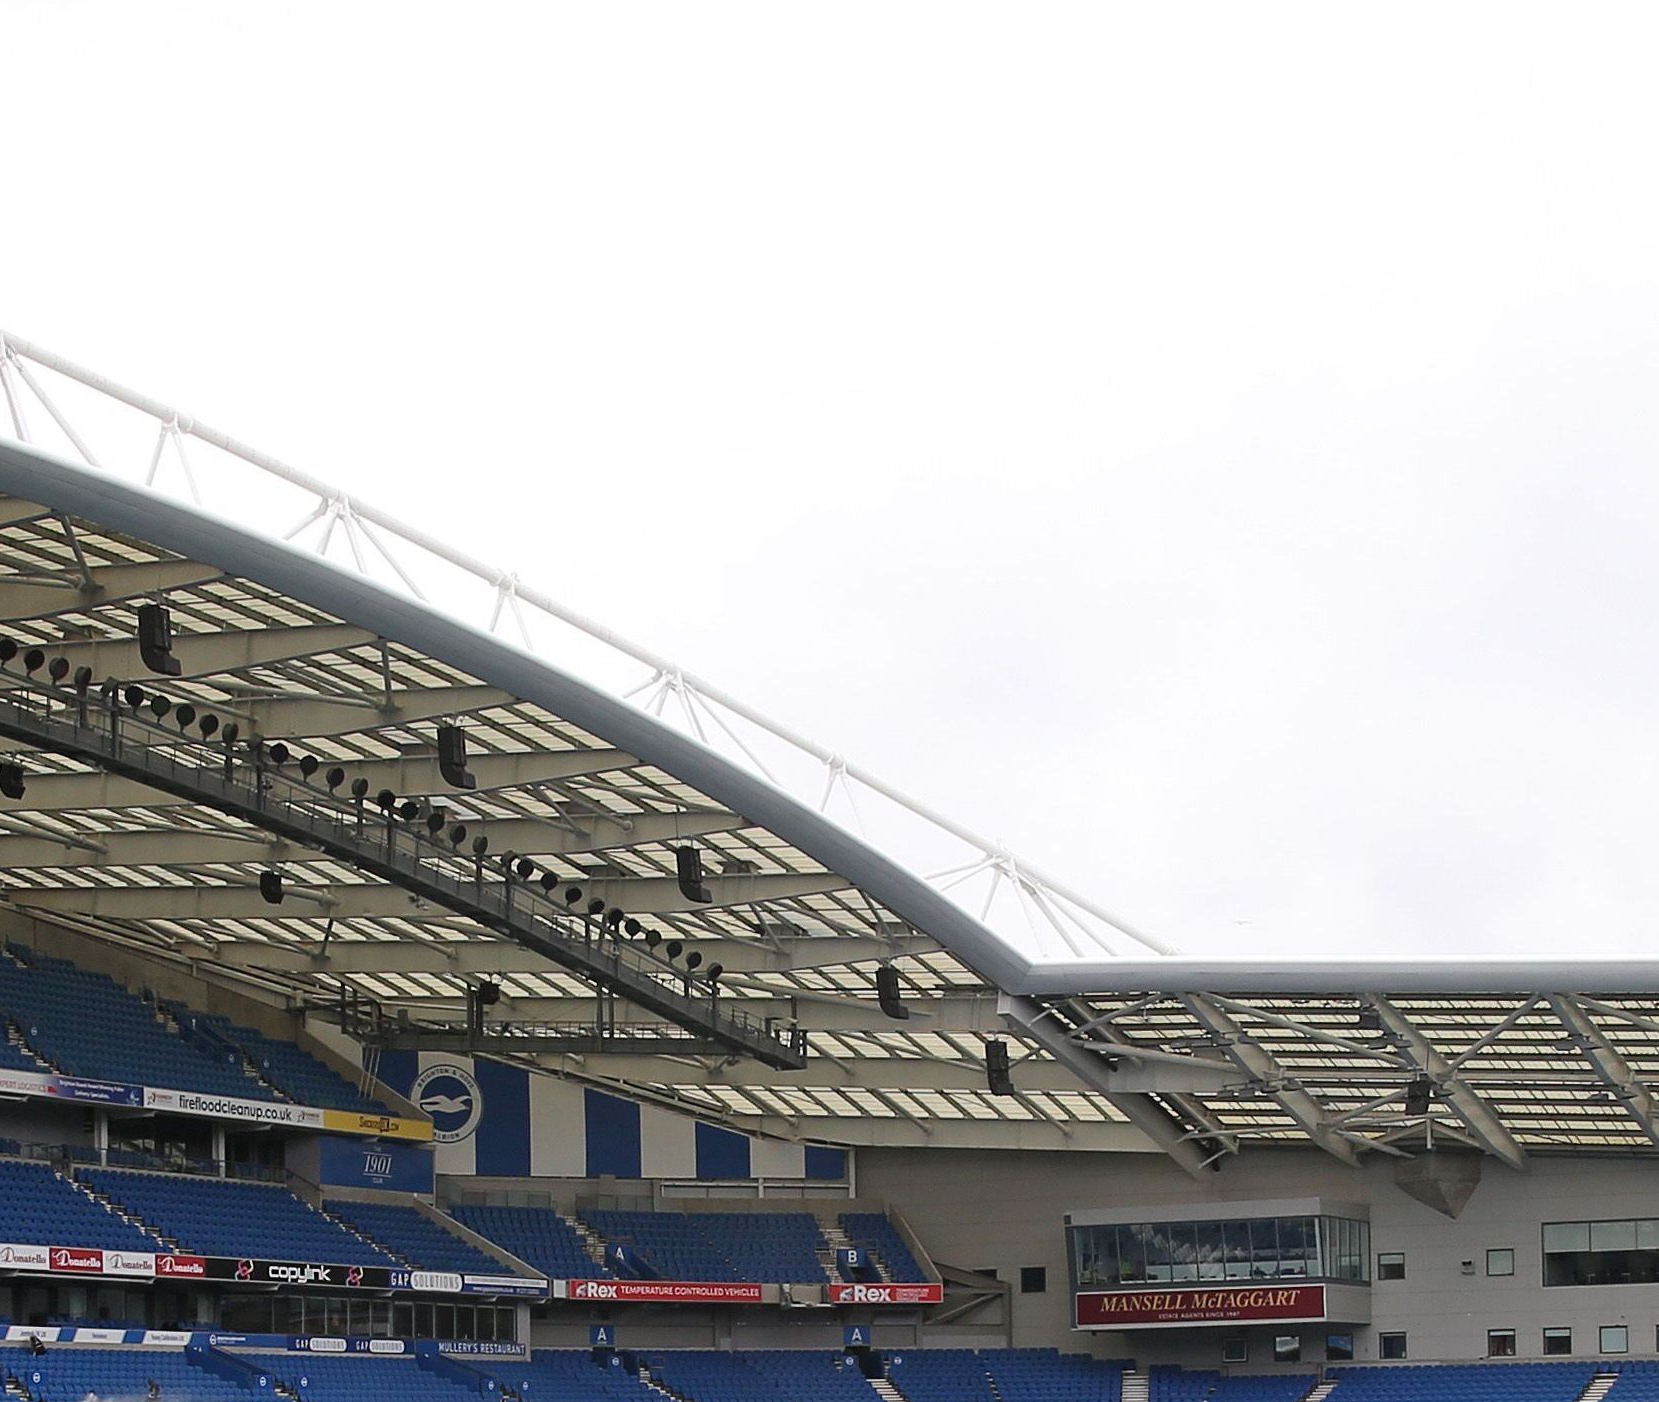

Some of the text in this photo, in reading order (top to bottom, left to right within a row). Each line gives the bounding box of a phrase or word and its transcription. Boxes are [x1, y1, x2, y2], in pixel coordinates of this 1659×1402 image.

[178, 1094, 292, 1122] firefloodcleanup.co.uk
[365, 1155, 391, 1174] 1901
[52, 1250, 101, 1268] Donatello
[108, 1254, 153, 1270] Donatello
[848, 1250, 857, 1262] B
[158, 1256, 204, 1274] Donatello
[268, 1264, 332, 1283] copylink
[391, 1271, 409, 1287] GAP
[413, 1273, 461, 1291] SOLUTIONS
[587, 1282, 760, 1299] Rex TEMPERATURE CONTROLLED VEHICLES
[854, 1287, 891, 1302] Rex
[1100, 1290, 1301, 1313] MANSELL McTAGGART
[597, 1328, 607, 1340] A
[851, 1328, 862, 1340] A
[295, 1339, 308, 1349] GAP
[356, 1340, 369, 1350] GAP
[439, 1342, 526, 1355] MULLERY'S RESTAURANT
